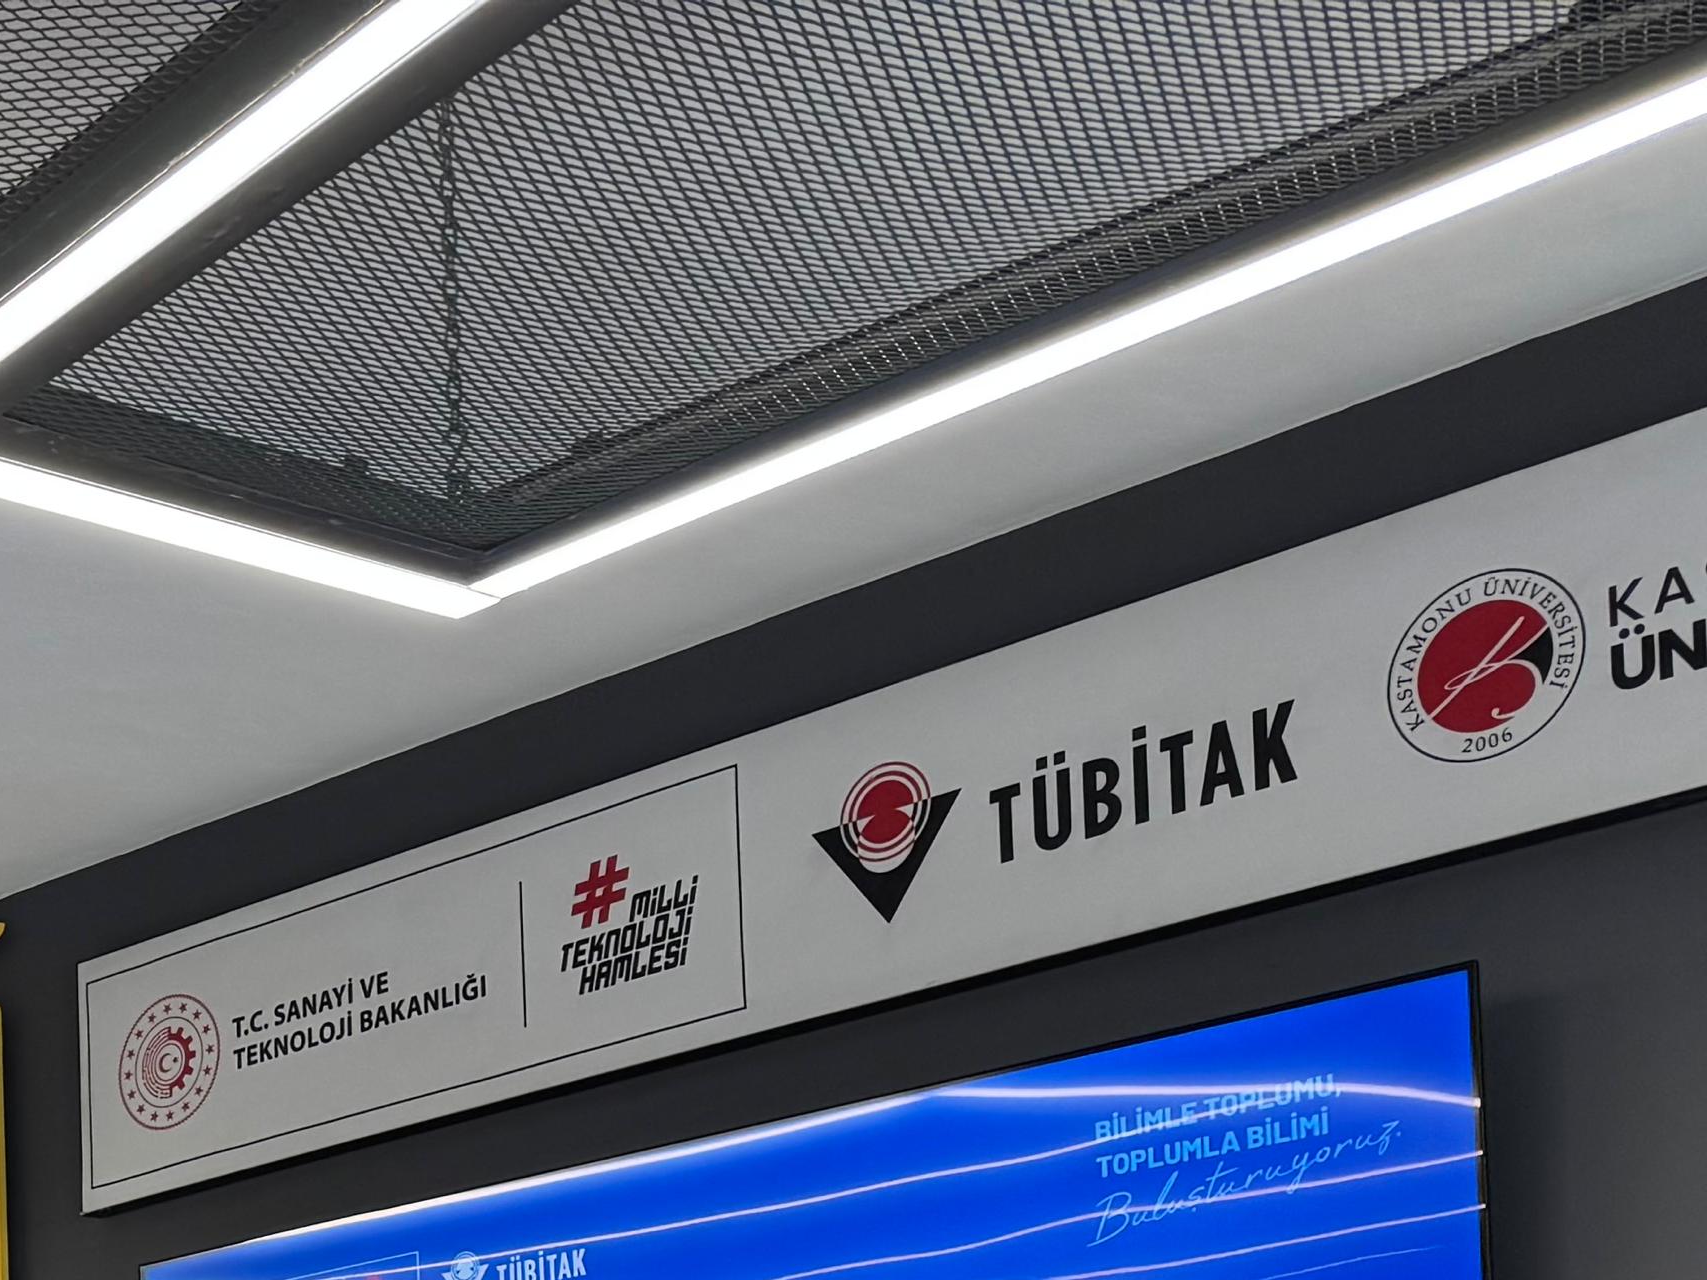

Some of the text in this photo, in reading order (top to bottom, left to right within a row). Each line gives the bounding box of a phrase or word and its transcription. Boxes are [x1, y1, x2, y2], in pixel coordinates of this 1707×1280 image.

[1608, 566, 1707, 628] KA
[1397, 576, 1579, 732] KASTAMONU ÜNİVERSİTESİ
[1462, 727, 1514, 754] 2006
[989, 699, 1299, 865] TÜBİTAK
[559, 906, 694, 973] TEKNOLOJİ
[578, 937, 690, 996] HAMLESİ
[232, 970, 390, 1039] T.C. SANAYİ VE
[233, 972, 488, 1070] TEKNOLOJİ BAKANLIĞI
[1094, 1102, 1199, 1144] BİLİMLE
[1096, 1106, 1330, 1179] TOPLUMLA BİLİMİ
